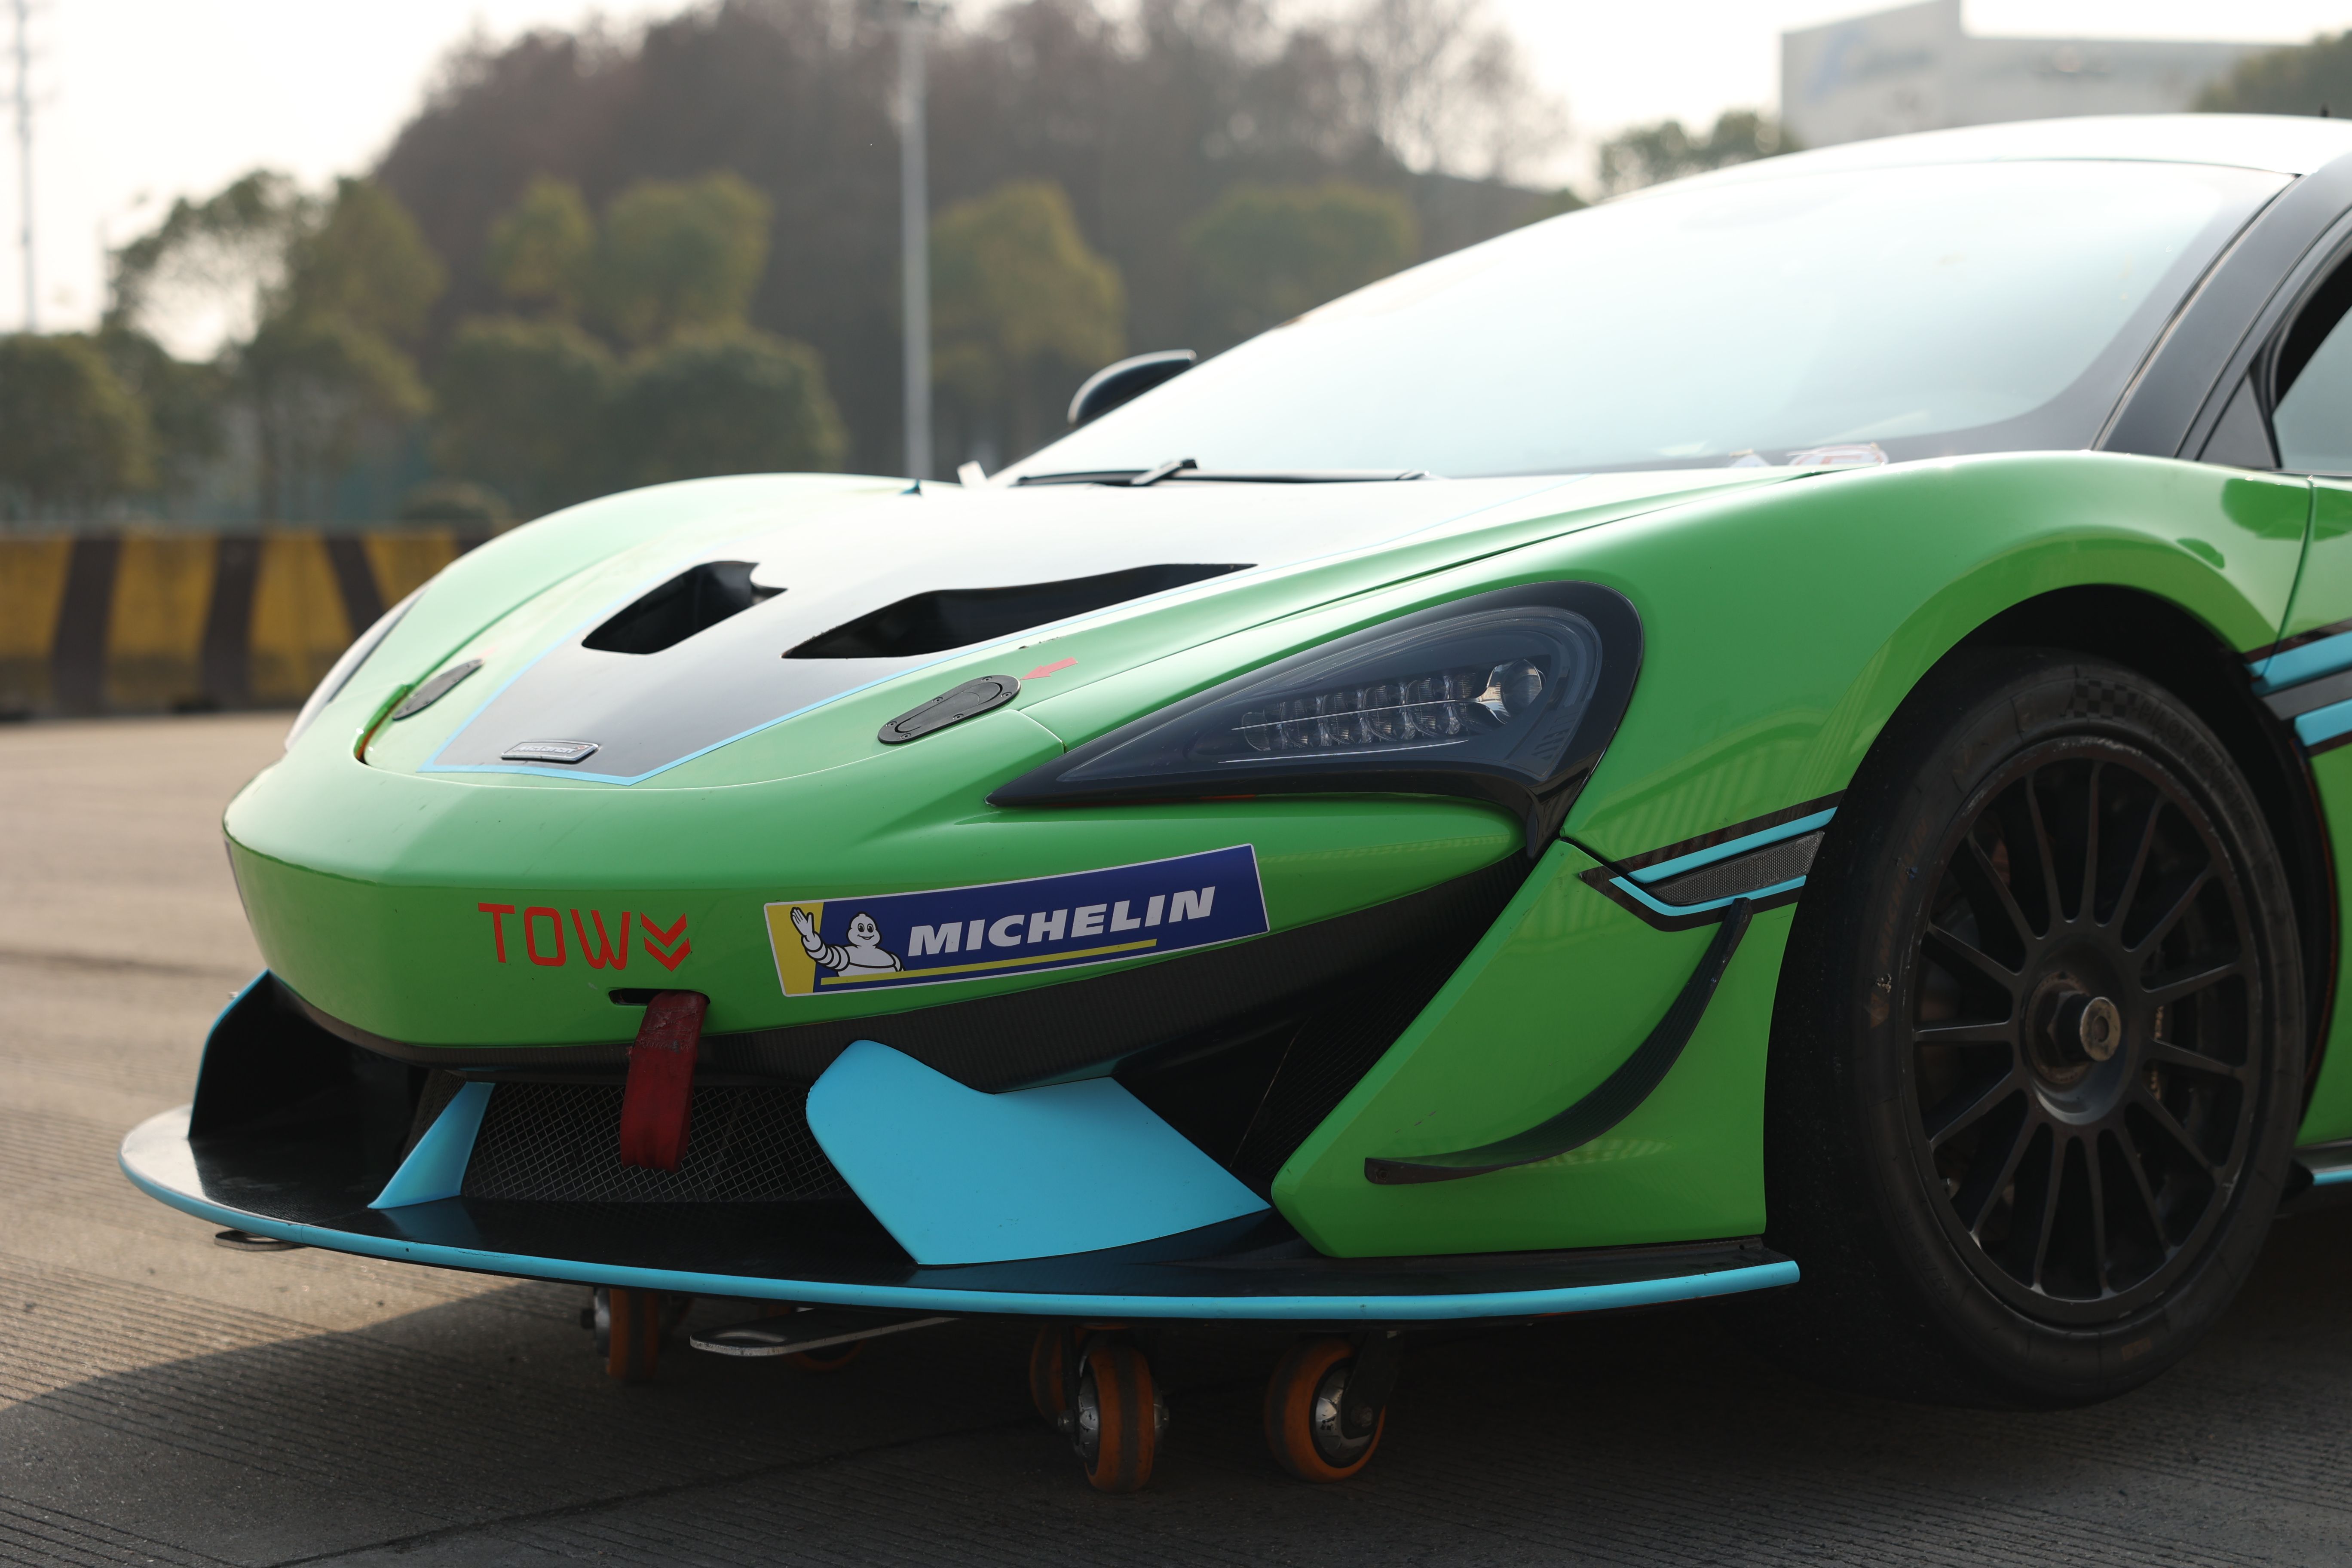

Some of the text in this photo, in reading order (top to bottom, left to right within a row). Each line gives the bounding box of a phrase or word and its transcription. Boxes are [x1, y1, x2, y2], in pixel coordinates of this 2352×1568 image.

[2138, 702, 2194, 747] PILOT
[478, 902, 631, 970] TOW
[908, 886, 1216, 956] MICHELIN
